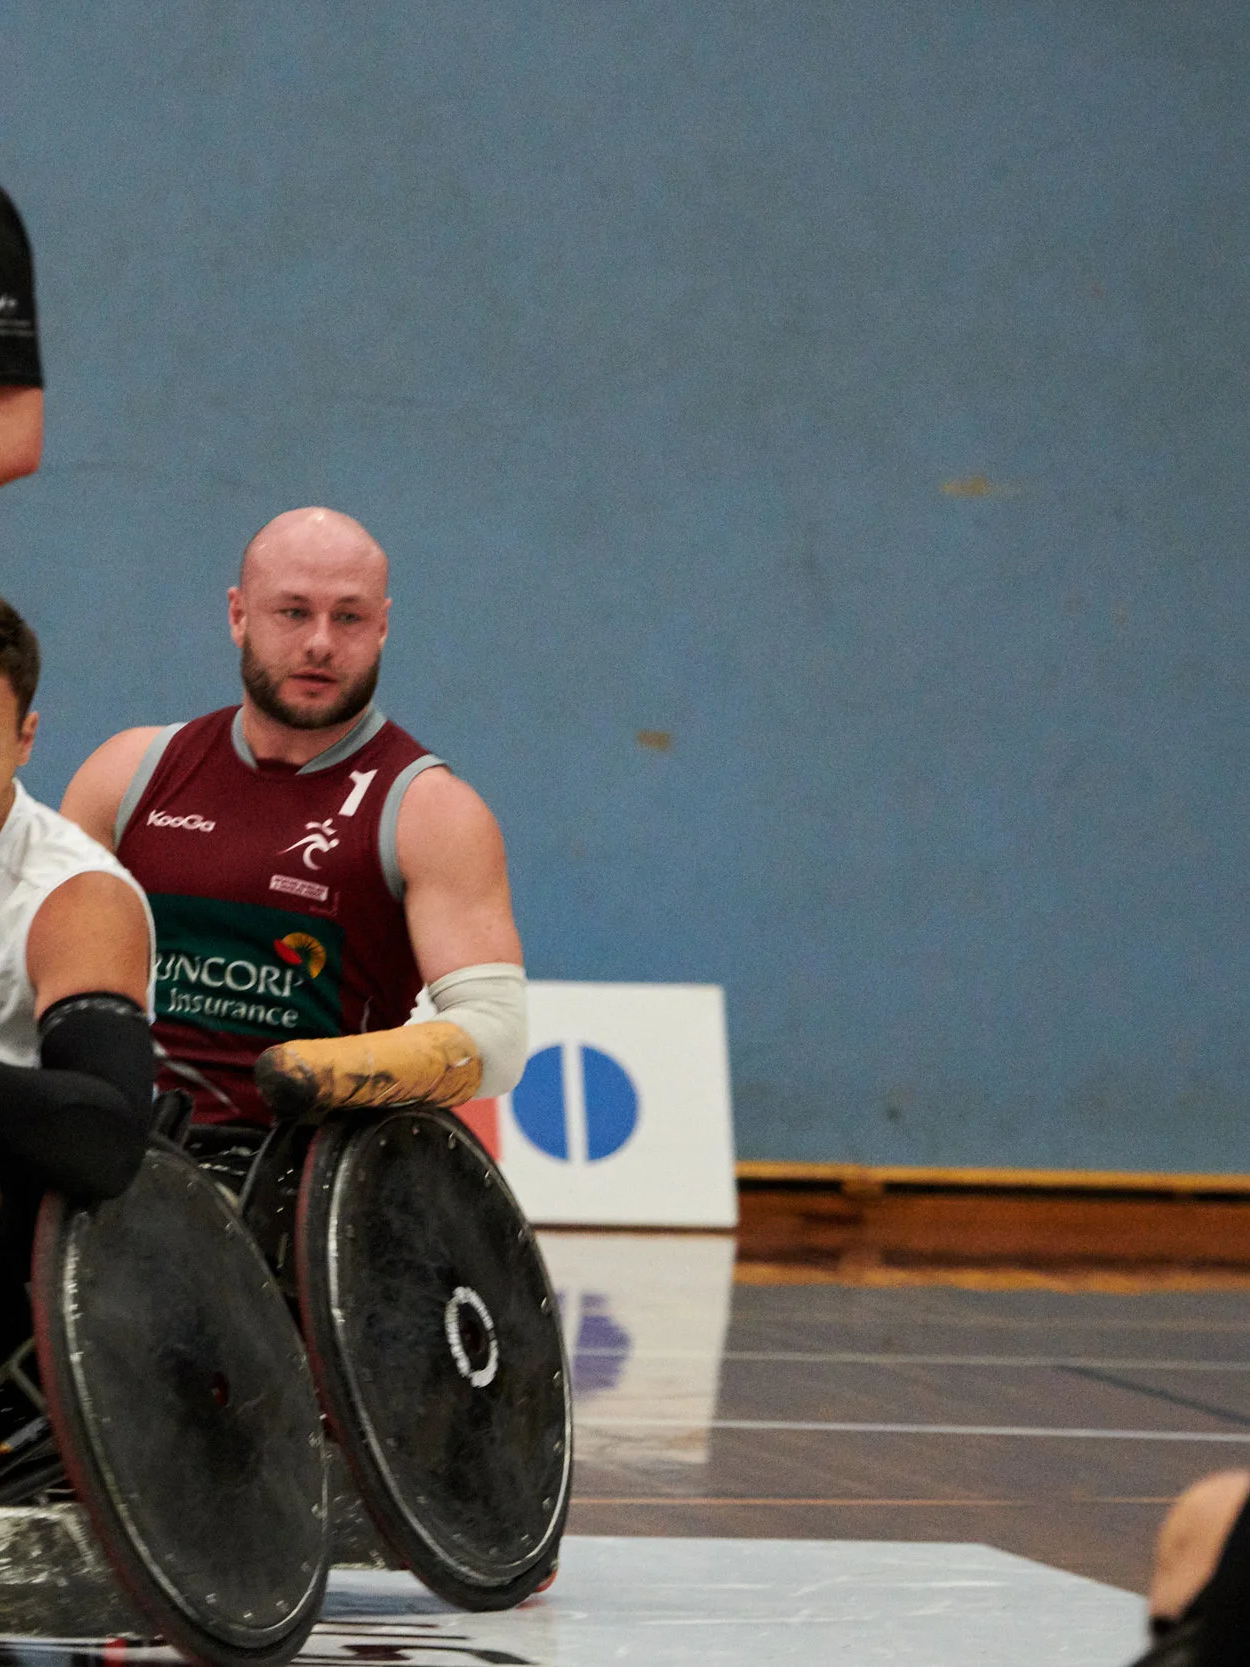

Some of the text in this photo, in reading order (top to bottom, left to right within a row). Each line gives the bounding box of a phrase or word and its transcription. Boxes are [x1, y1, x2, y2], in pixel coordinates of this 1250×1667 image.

[338, 769, 378, 817] 1
[147, 809, 216, 832] KooGa
[154, 952, 303, 998] UNCORP
[167, 986, 300, 1029] Insurance
